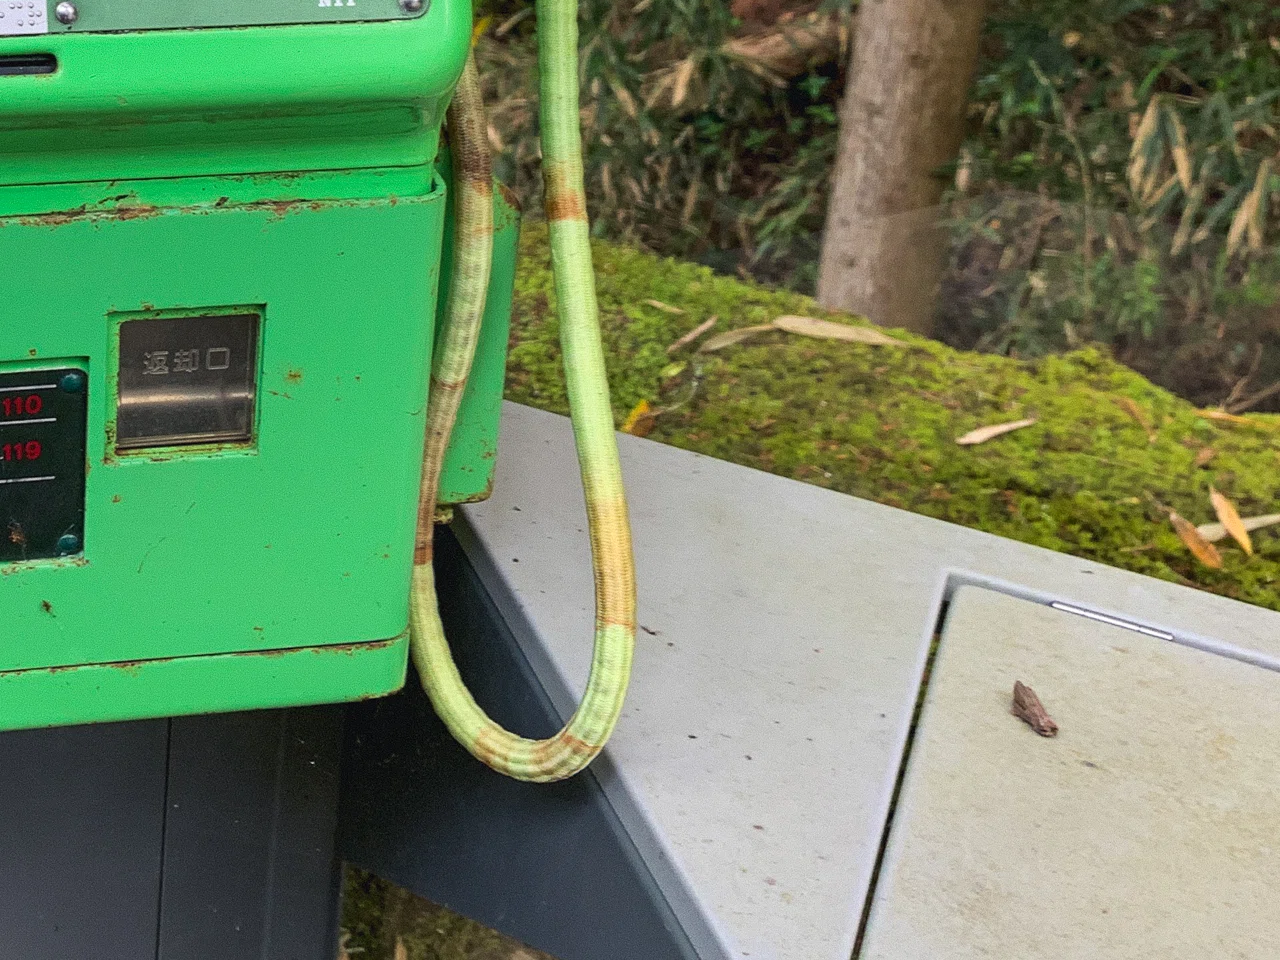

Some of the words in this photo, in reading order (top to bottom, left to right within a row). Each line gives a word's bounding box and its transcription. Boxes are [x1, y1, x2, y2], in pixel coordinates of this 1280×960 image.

[142, 347, 230, 375] 返却口
[2, 395, 42, 416] 110
[2, 440, 42, 461] 119
